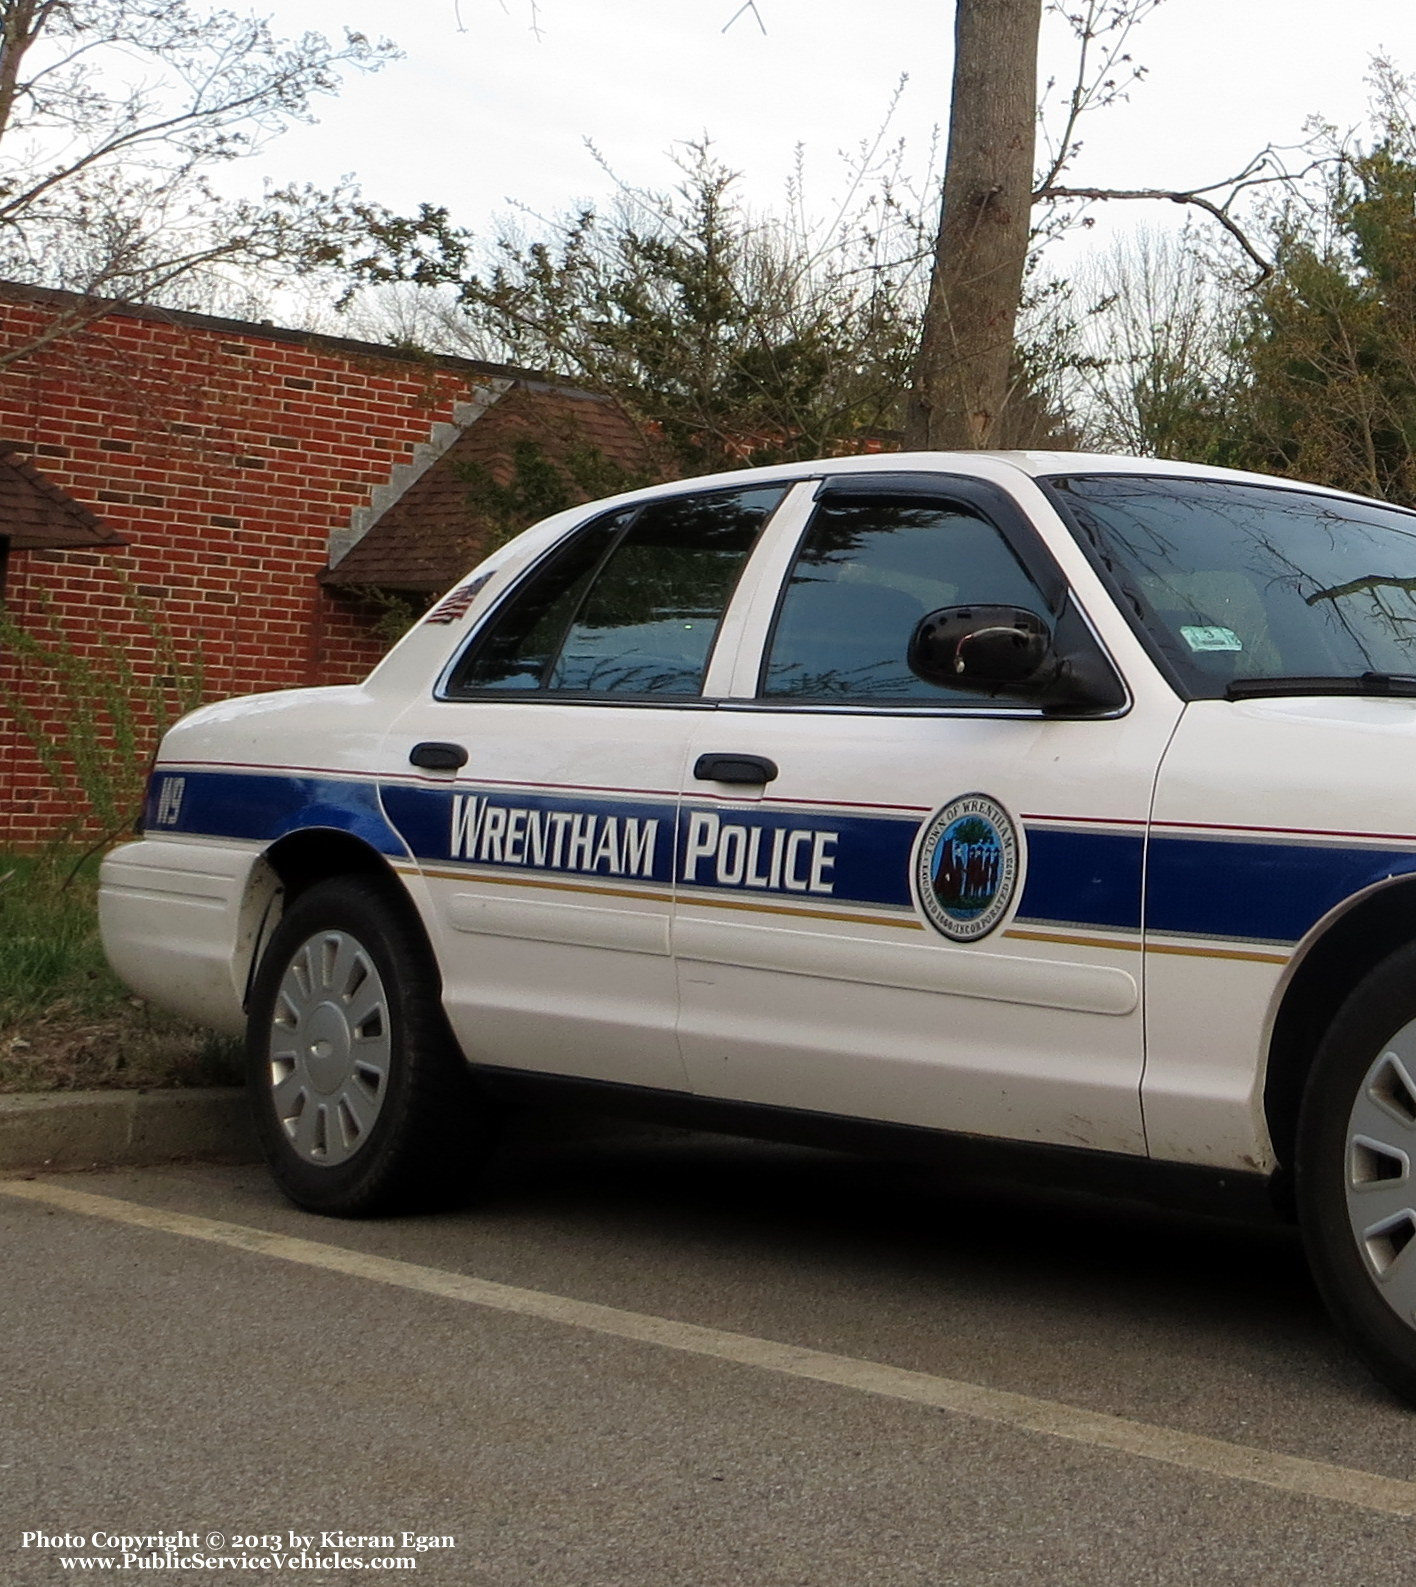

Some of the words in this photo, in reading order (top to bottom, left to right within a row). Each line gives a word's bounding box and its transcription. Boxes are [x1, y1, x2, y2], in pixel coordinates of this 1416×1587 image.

[157, 776, 186, 825] W9
[451, 794, 660, 877] WRENTHAM
[683, 811, 839, 893] POLICE
[925, 817, 948, 857] TOWN
[946, 804, 961, 822] OF
[962, 800, 1013, 850] WRENTHAM
[955, 885, 1010, 935] INCORPORATED
